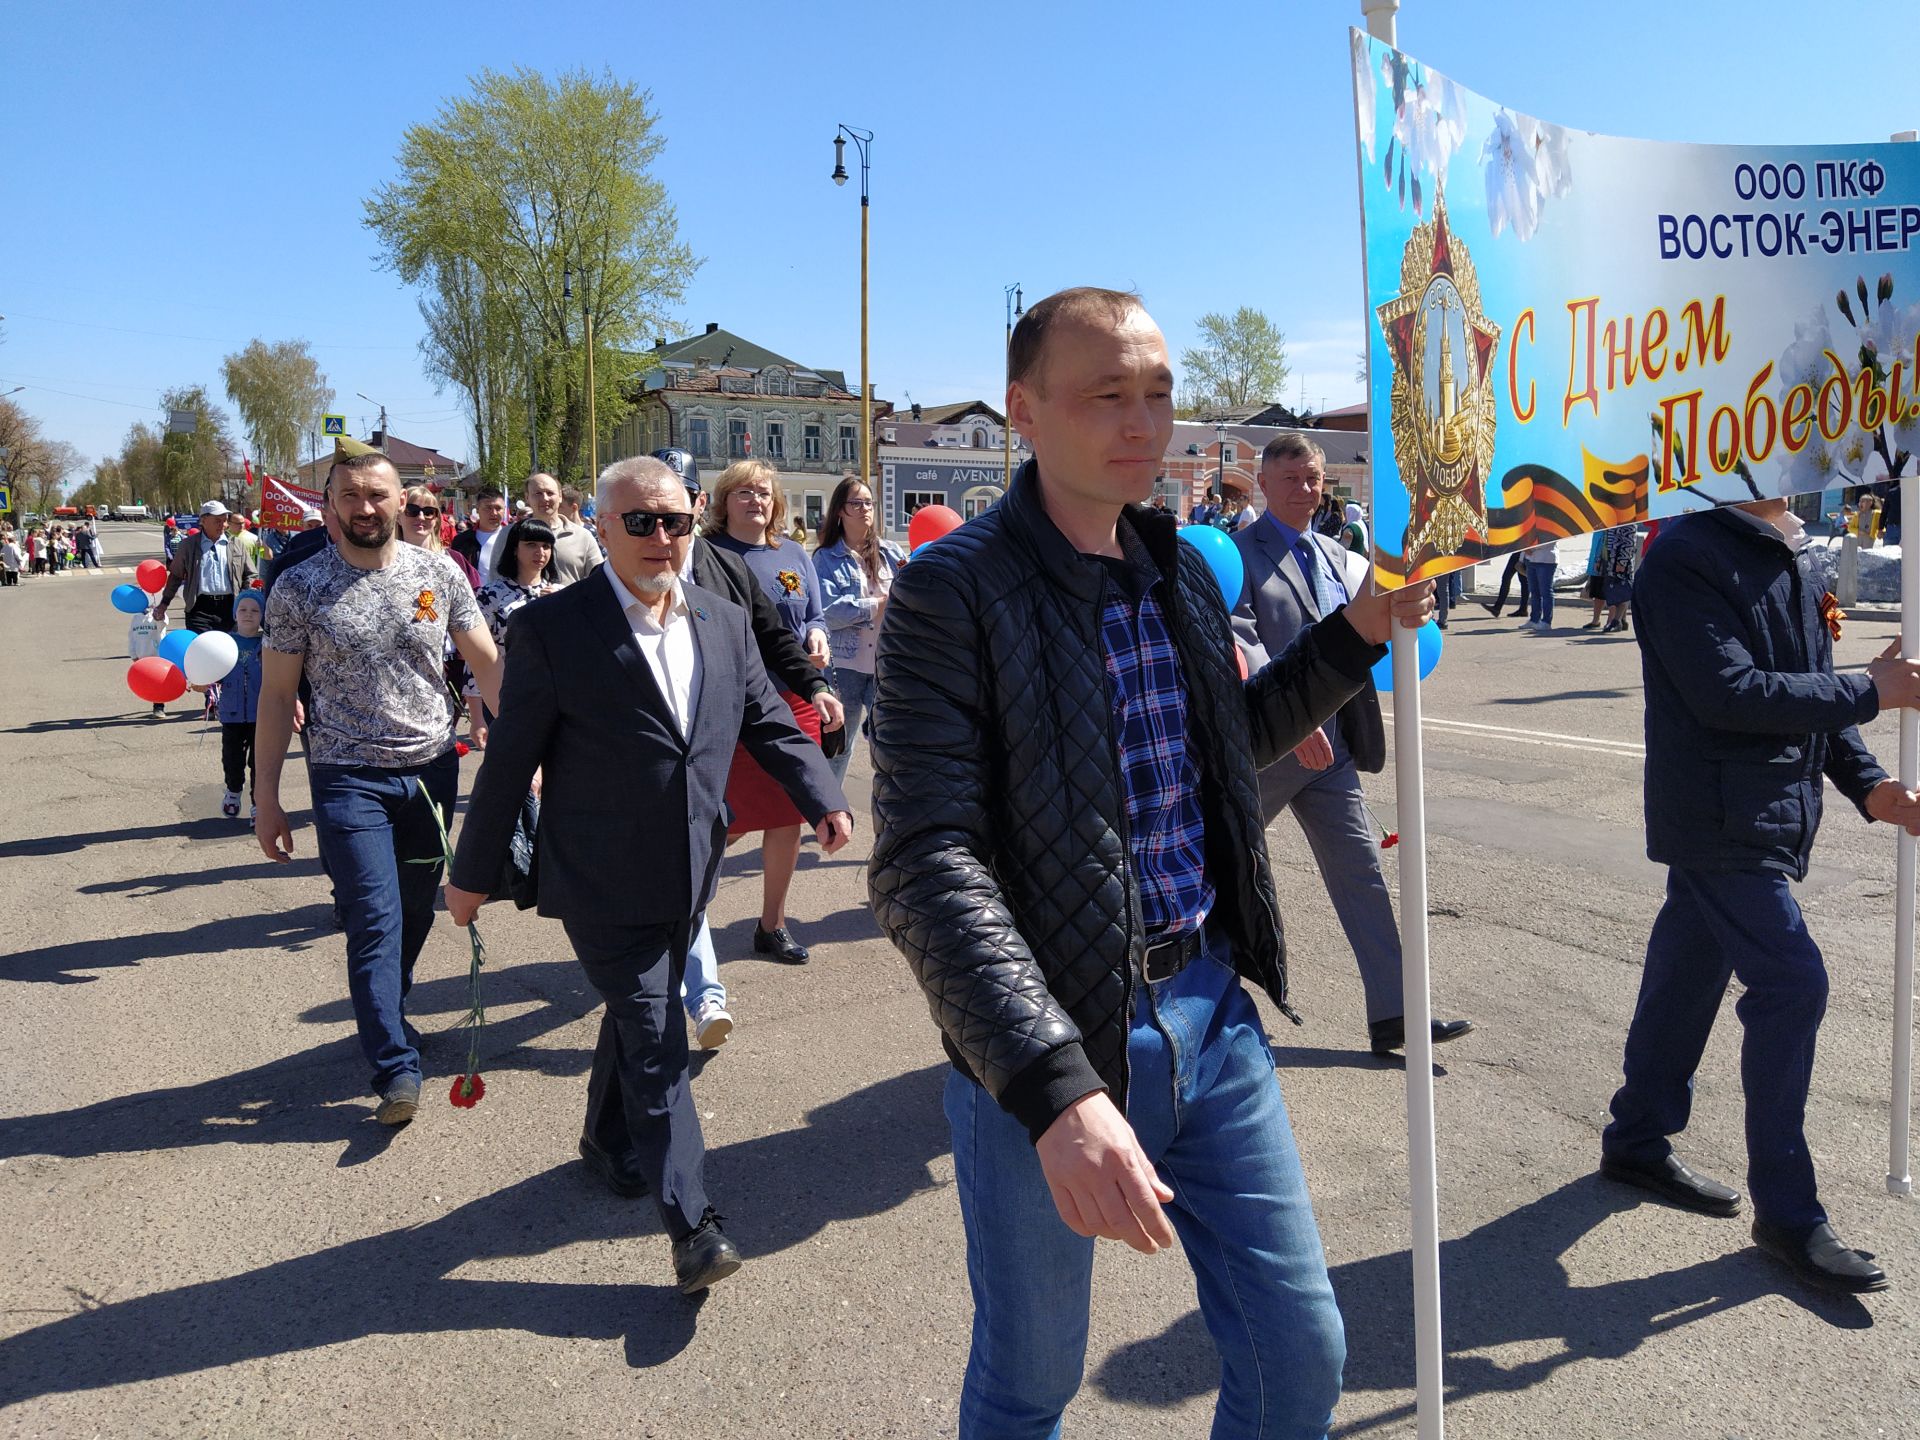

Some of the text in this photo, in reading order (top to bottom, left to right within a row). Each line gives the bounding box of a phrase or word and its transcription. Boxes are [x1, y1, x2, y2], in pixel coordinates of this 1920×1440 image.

[1735, 161, 1885, 200] ООО ПКФ
[1658, 207, 1920, 259] ВОСТОК-ЭНЕР
[1508, 294, 1731, 428] С Днем
[1658, 331, 1920, 494] Победы!
[916, 469, 938, 481] café
[1433, 455, 1468, 488] ПОБЕДА
[265, 491, 289, 503] ООО
[276, 503, 299, 515] ООО
